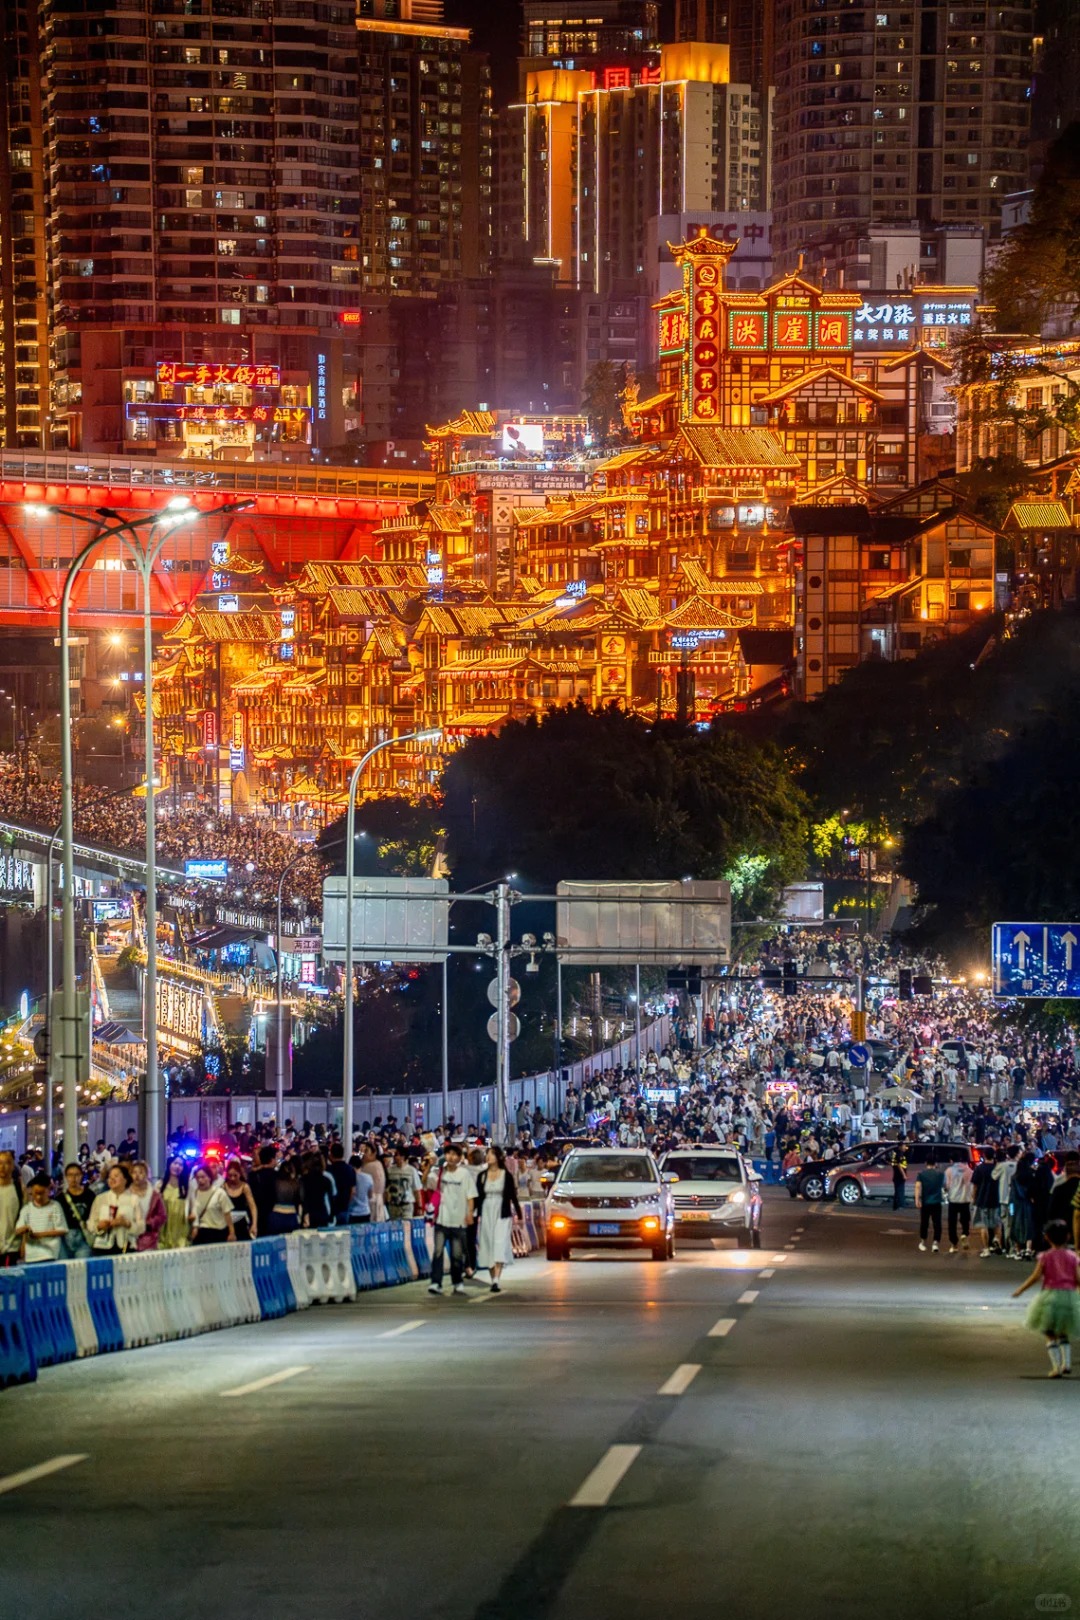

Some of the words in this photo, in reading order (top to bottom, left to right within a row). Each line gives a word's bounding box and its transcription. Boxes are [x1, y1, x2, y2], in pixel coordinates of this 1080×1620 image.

[923, 313, 971, 324] 重庆火锅
[736, 318, 842, 343] 洪崖洞
[854, 329, 909, 340] 金奖锅底
[318, 354, 326, 418] 如家商旅酒店
[386, 441, 395, 456] P
